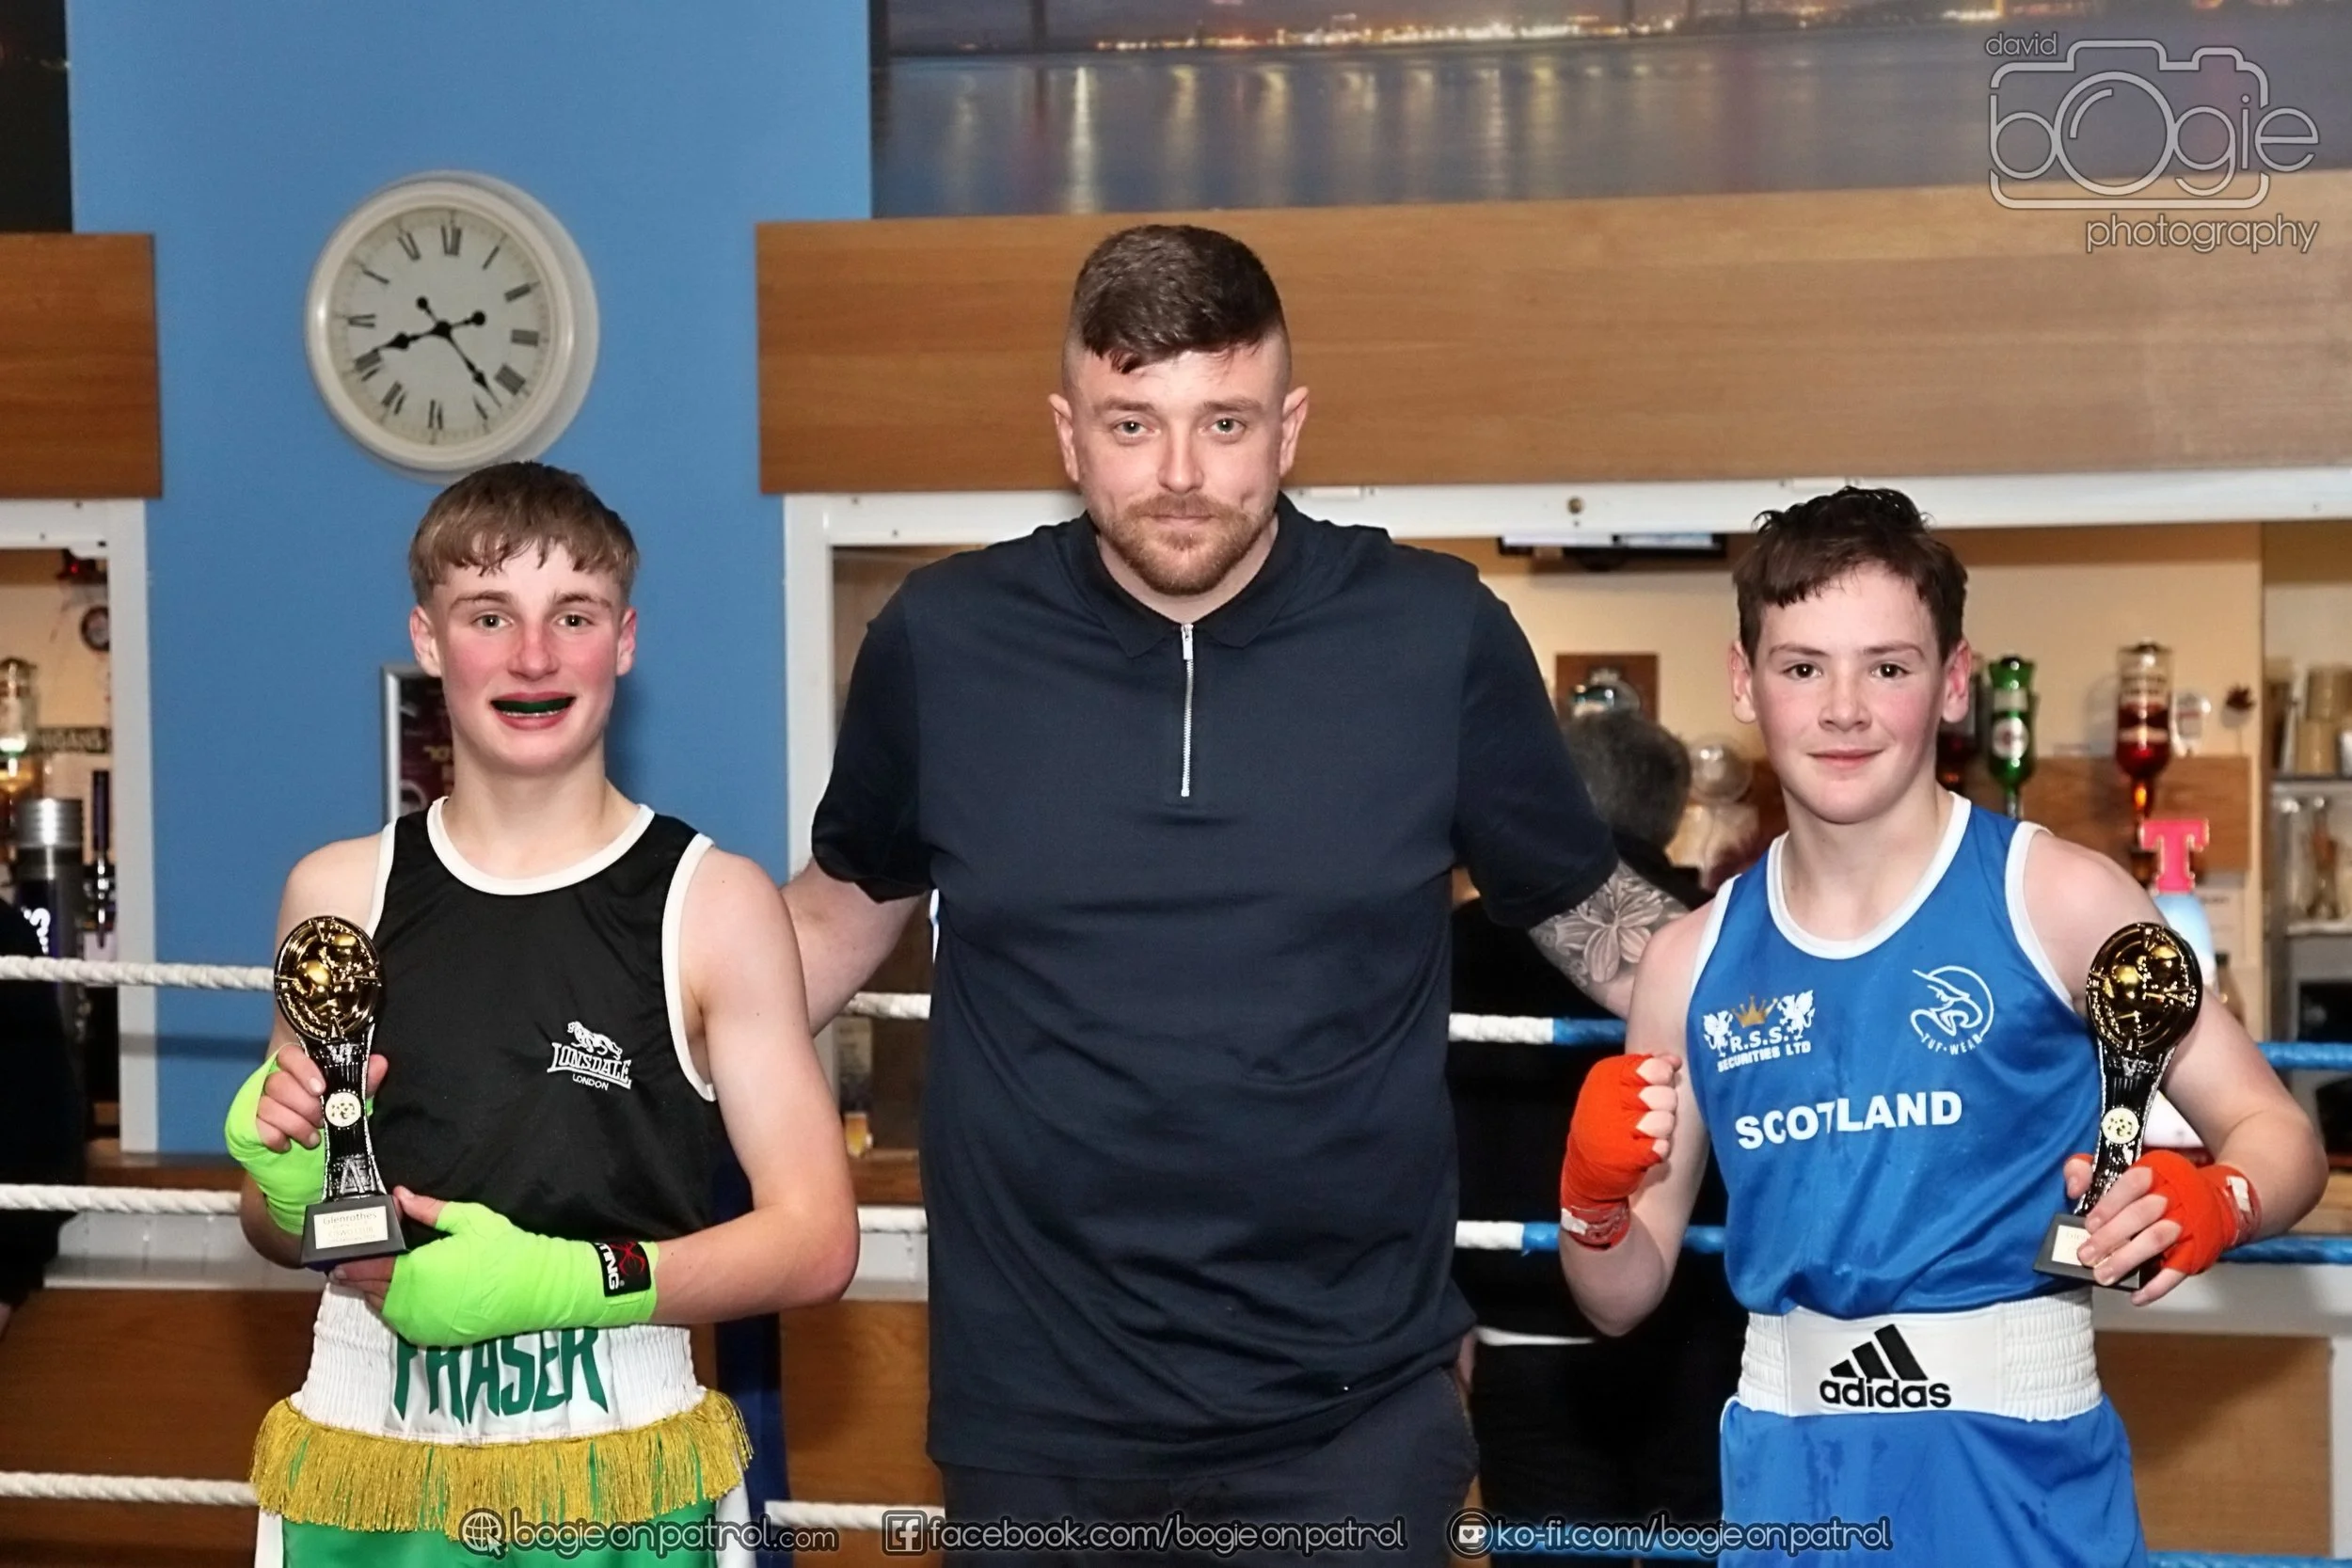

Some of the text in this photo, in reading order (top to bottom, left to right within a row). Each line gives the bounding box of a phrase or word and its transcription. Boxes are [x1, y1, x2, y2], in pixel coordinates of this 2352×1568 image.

[1730, 1026, 1788, 1053] R.S.S.
[548, 1042, 632, 1088] LONSDALE
[1717, 1040, 1811, 1072] SECURITIES LTD
[572, 1073, 610, 1091] LONDON
[1735, 1091, 1963, 1150] SCOTLAND
[595, 1243, 619, 1291] TING
[1820, 1377, 1951, 1408] adidas
